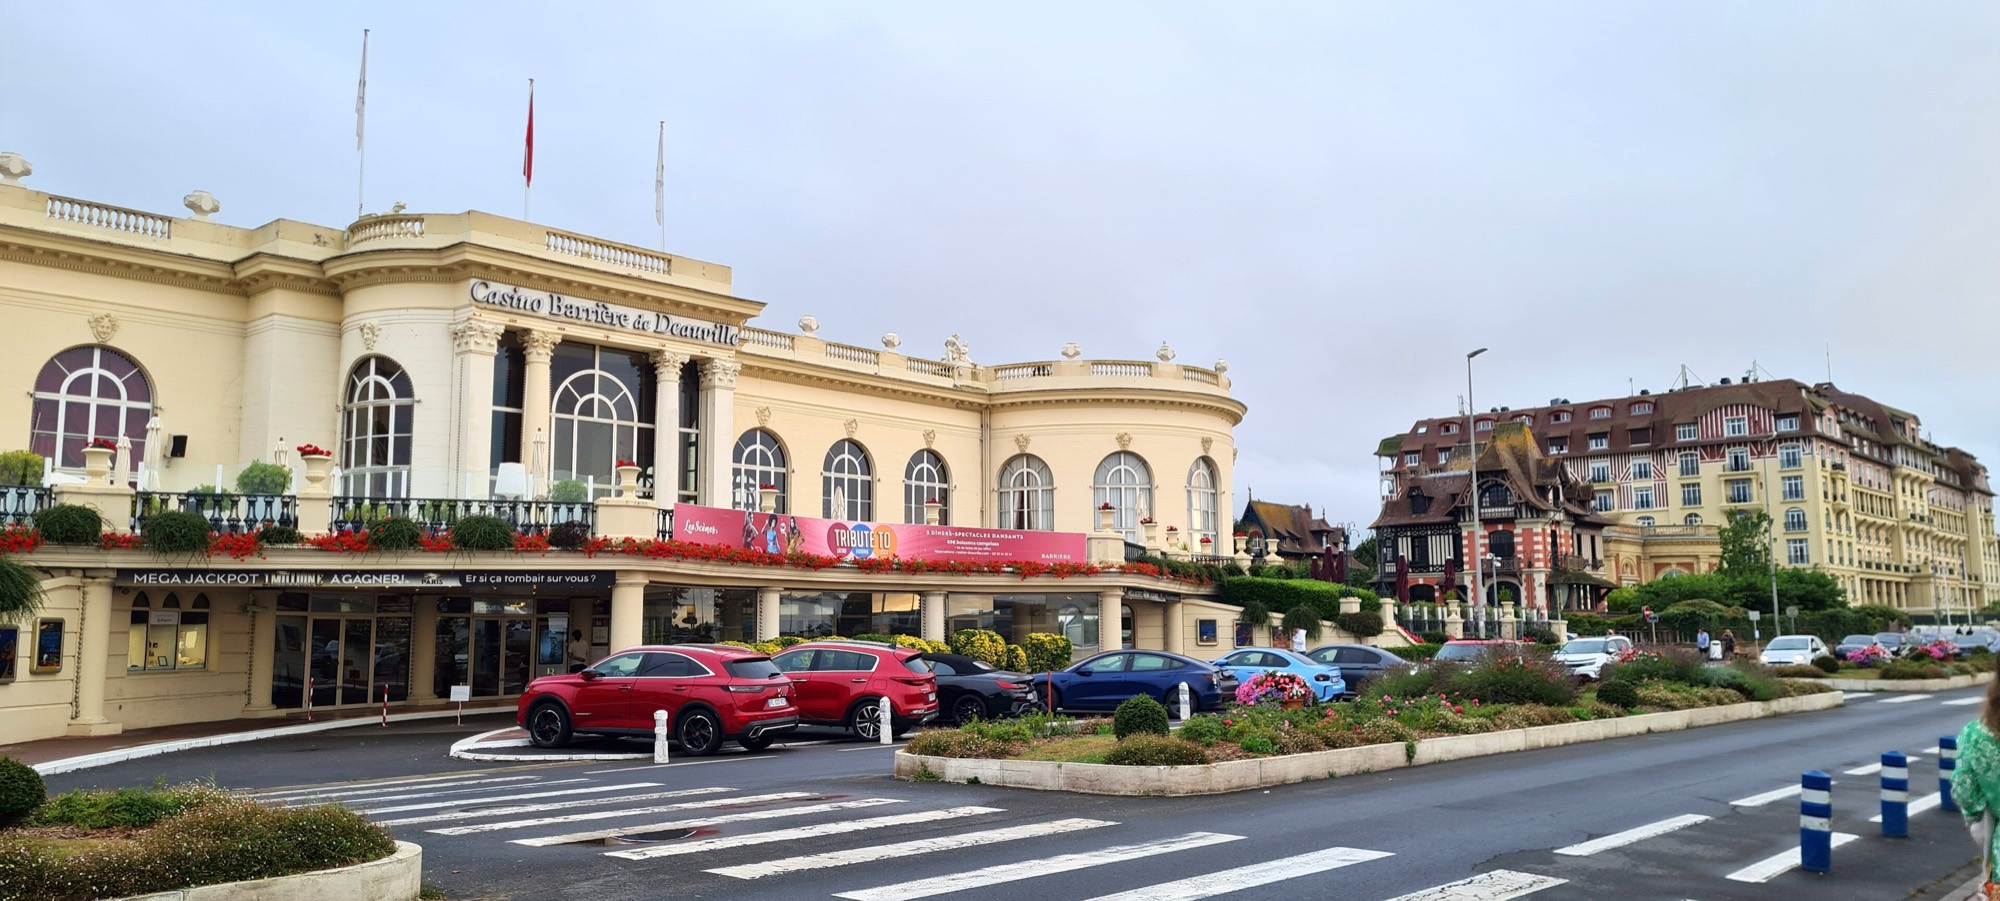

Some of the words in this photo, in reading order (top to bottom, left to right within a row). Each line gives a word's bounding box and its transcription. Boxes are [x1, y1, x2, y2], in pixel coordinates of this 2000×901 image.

[470, 280, 544, 312] Casino
[549, 293, 628, 327] Barrière
[632, 313, 652, 330] de
[654, 313, 740, 347] Deauville
[834, 529, 875, 548] TRIBUTE
[878, 531, 891, 549] TO
[992, 532, 1023, 540] DANSANTS
[133, 573, 181, 584] MEGA
[185, 573, 259, 584] JACKPOT
[465, 574, 476, 583] Et
[478, 574, 488, 583] si
[489, 575, 503, 585] ça
[504, 574, 545, 583] tombait
[564, 575, 589, 583] vous
